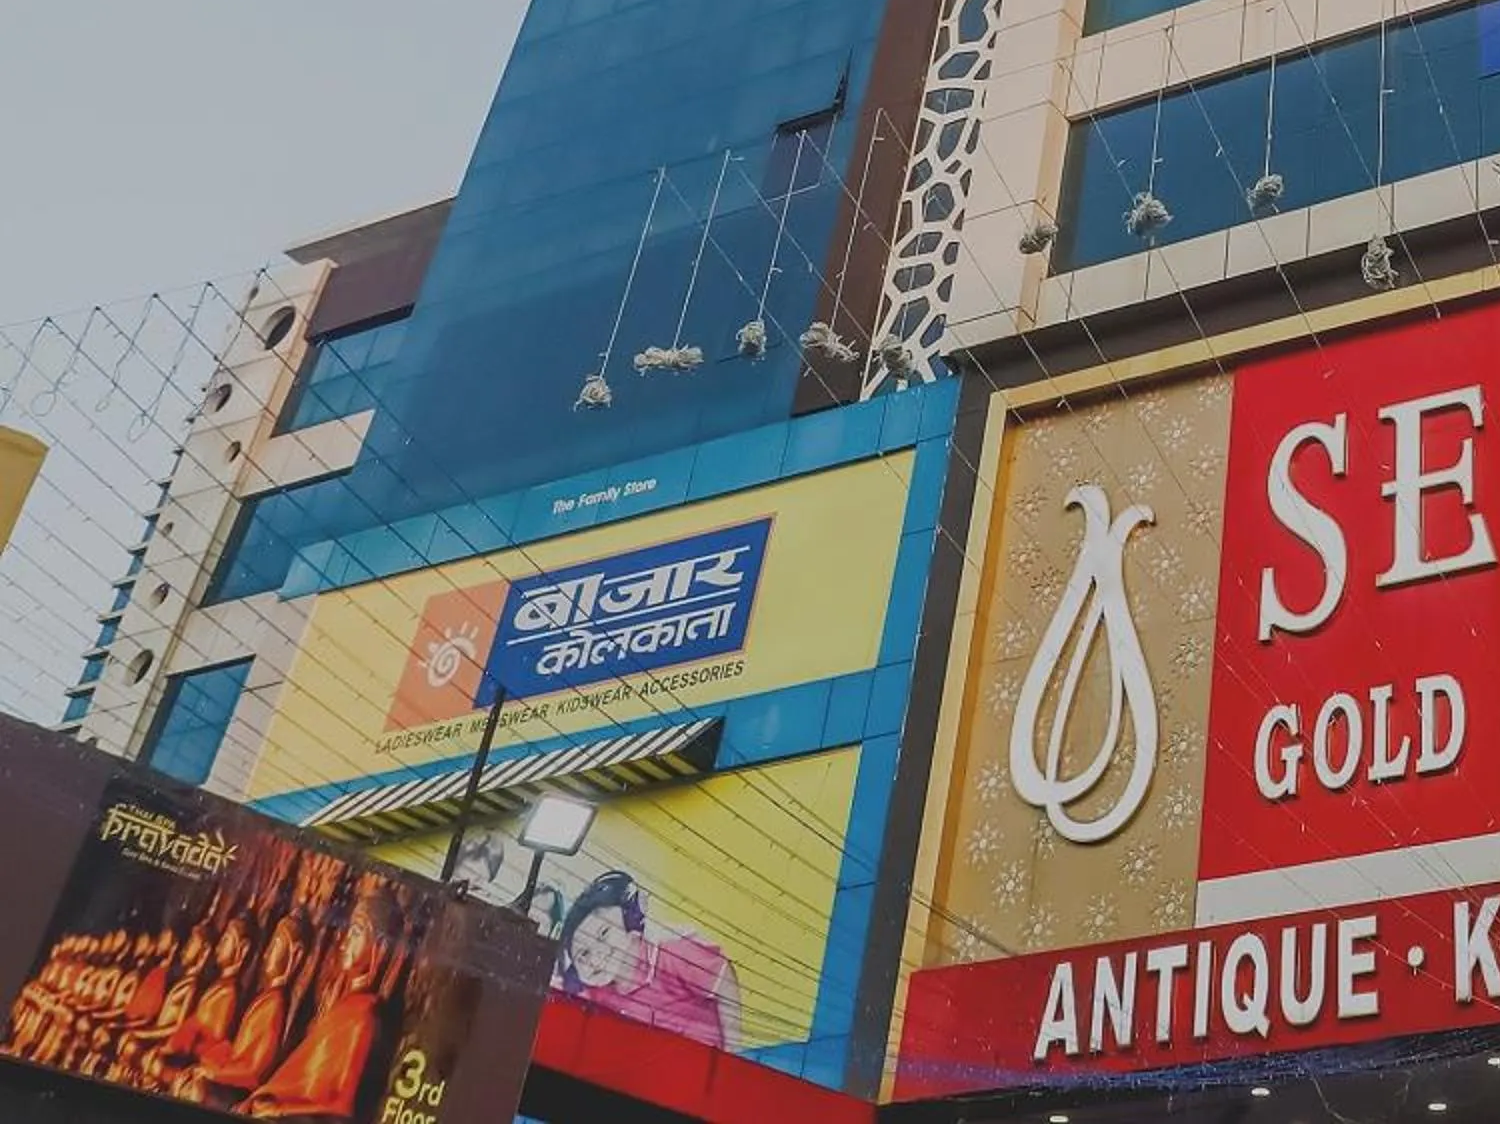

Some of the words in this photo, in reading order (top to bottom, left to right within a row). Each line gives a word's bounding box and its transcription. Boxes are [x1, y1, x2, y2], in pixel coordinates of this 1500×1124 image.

[553, 499, 575, 515] The
[578, 487, 621, 508] Family
[623, 479, 657, 497] Store
[512, 545, 751, 633] बाजार
[535, 601, 738, 677] कोलकाता
[375, 723, 463, 755] LADIESWEAR
[469, 705, 549, 735] MESWEAR
[556, 685, 632, 716] KIDSWEAR
[637, 660, 745, 698] ACCESSORIES
[1254, 674, 1467, 800] GOLD
[1033, 915, 1380, 1060] ANTIQUE
[395, 1049, 446, 1107] 3rd
